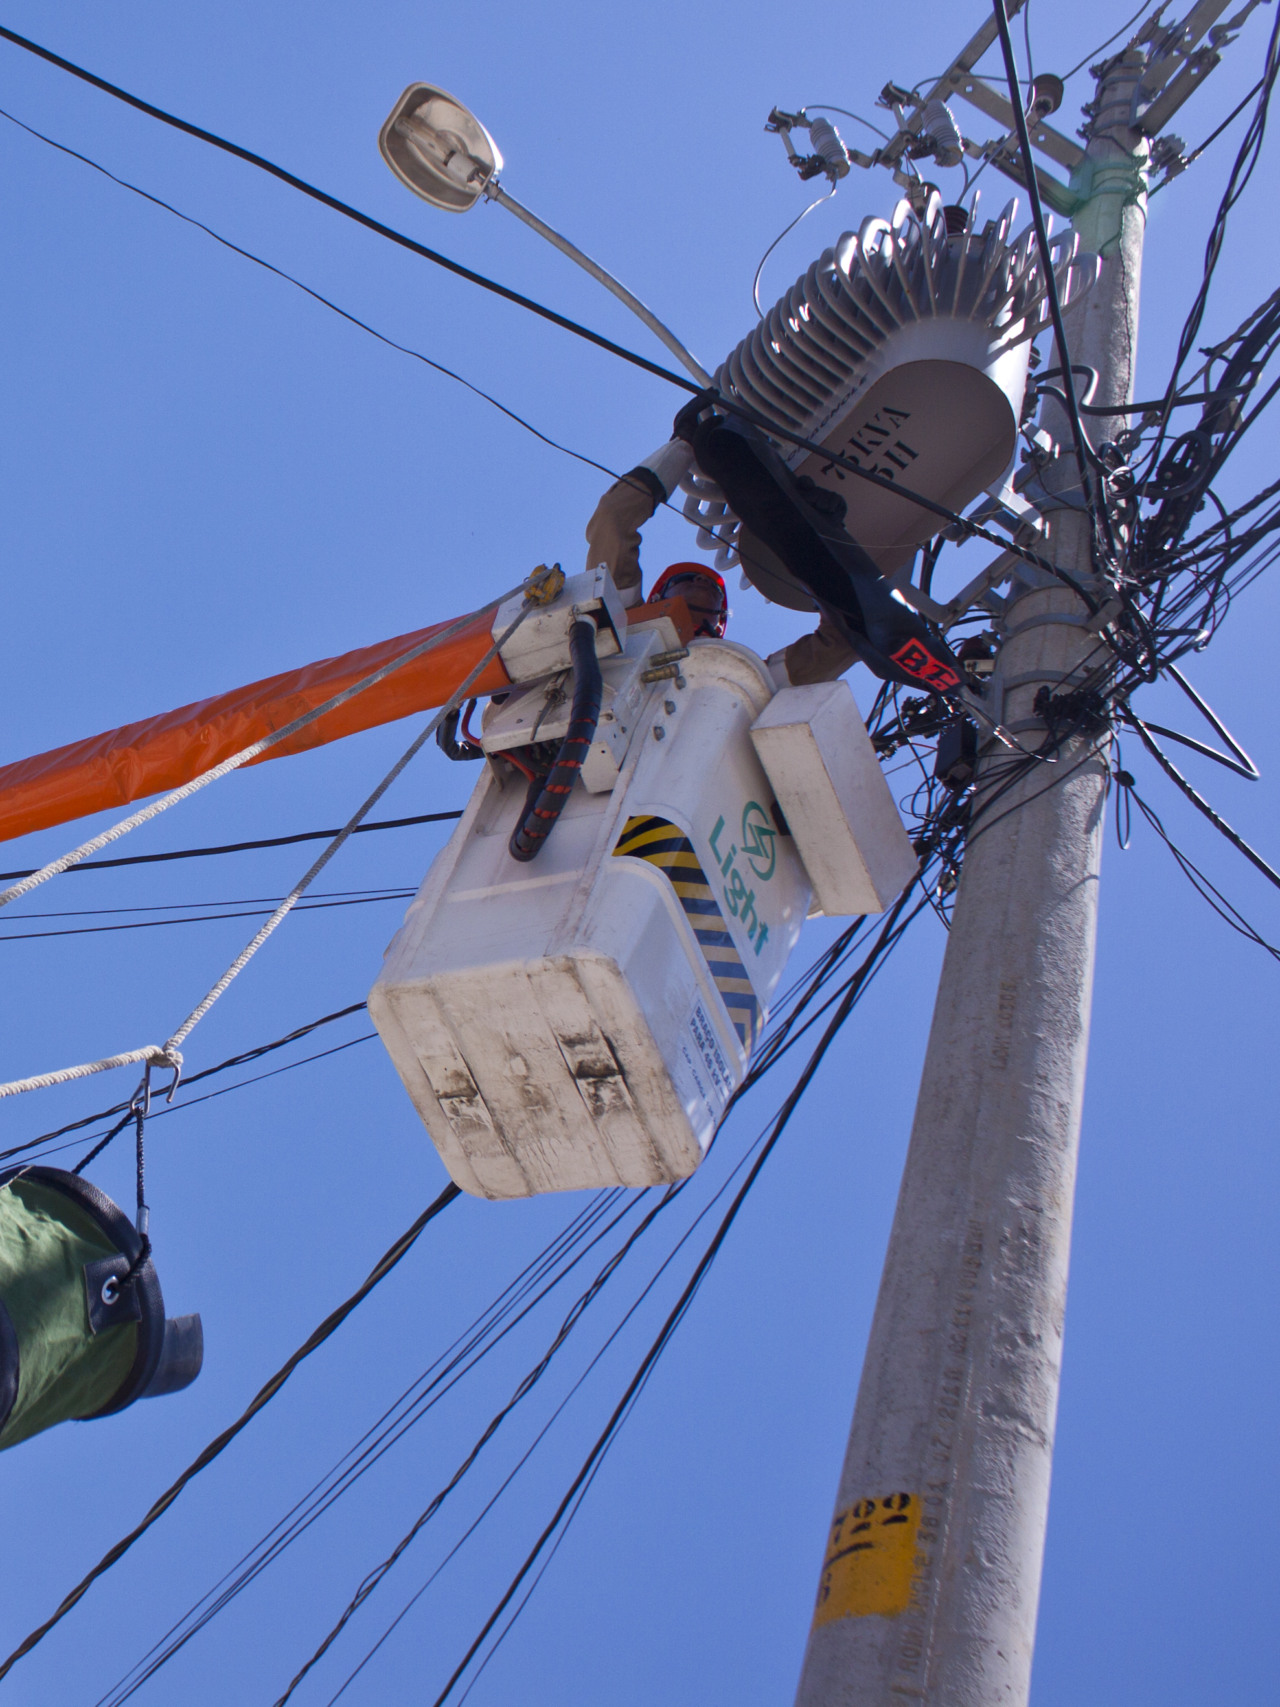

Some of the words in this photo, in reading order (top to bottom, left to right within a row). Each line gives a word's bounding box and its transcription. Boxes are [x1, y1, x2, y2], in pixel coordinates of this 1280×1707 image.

[708, 815, 770, 957] Light
[690, 1017, 705, 1053] PARA
[695, 1006, 715, 1050] BRAÇO
